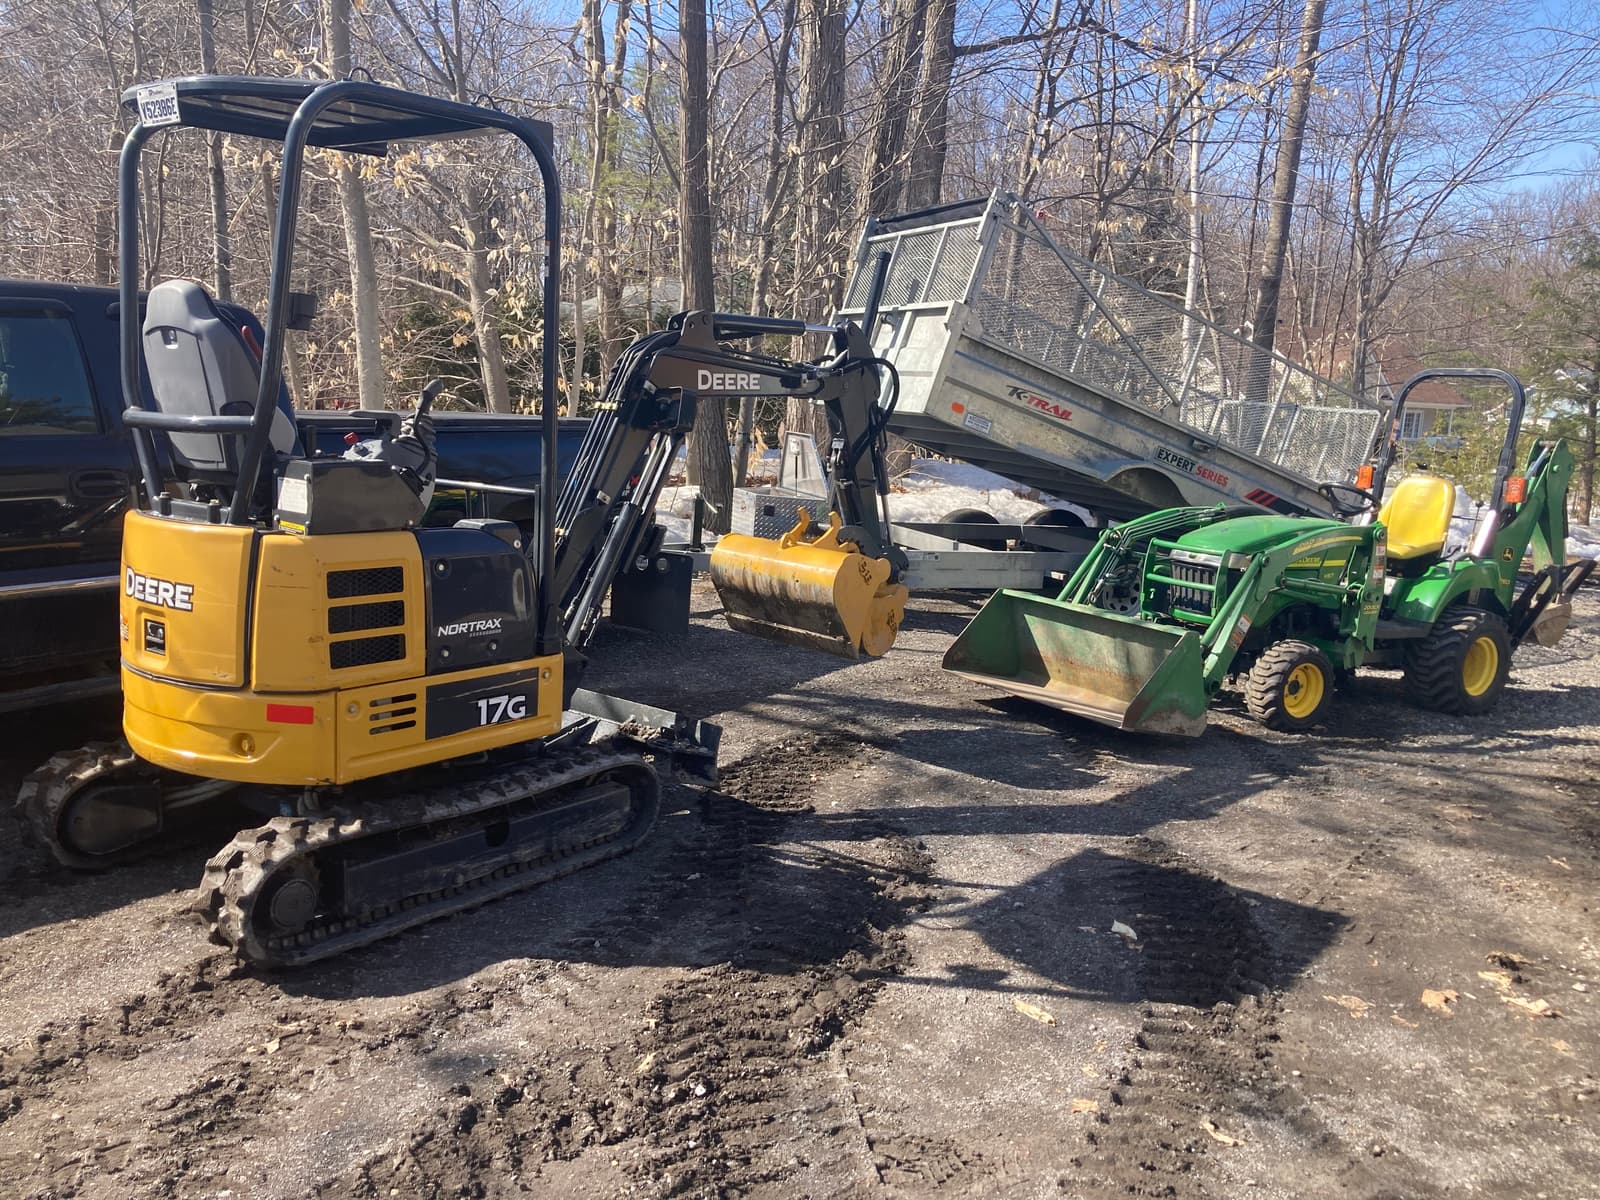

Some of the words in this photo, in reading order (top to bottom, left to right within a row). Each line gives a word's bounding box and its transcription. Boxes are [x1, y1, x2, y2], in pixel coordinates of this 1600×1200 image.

[697, 369, 761, 391] DEERE
[1157, 448, 1196, 473] EXPERT
[1195, 465, 1229, 487] SERIES
[125, 566, 193, 611] DEERE
[437, 618, 502, 637] NORTRAX
[477, 694, 526, 726] 17G
